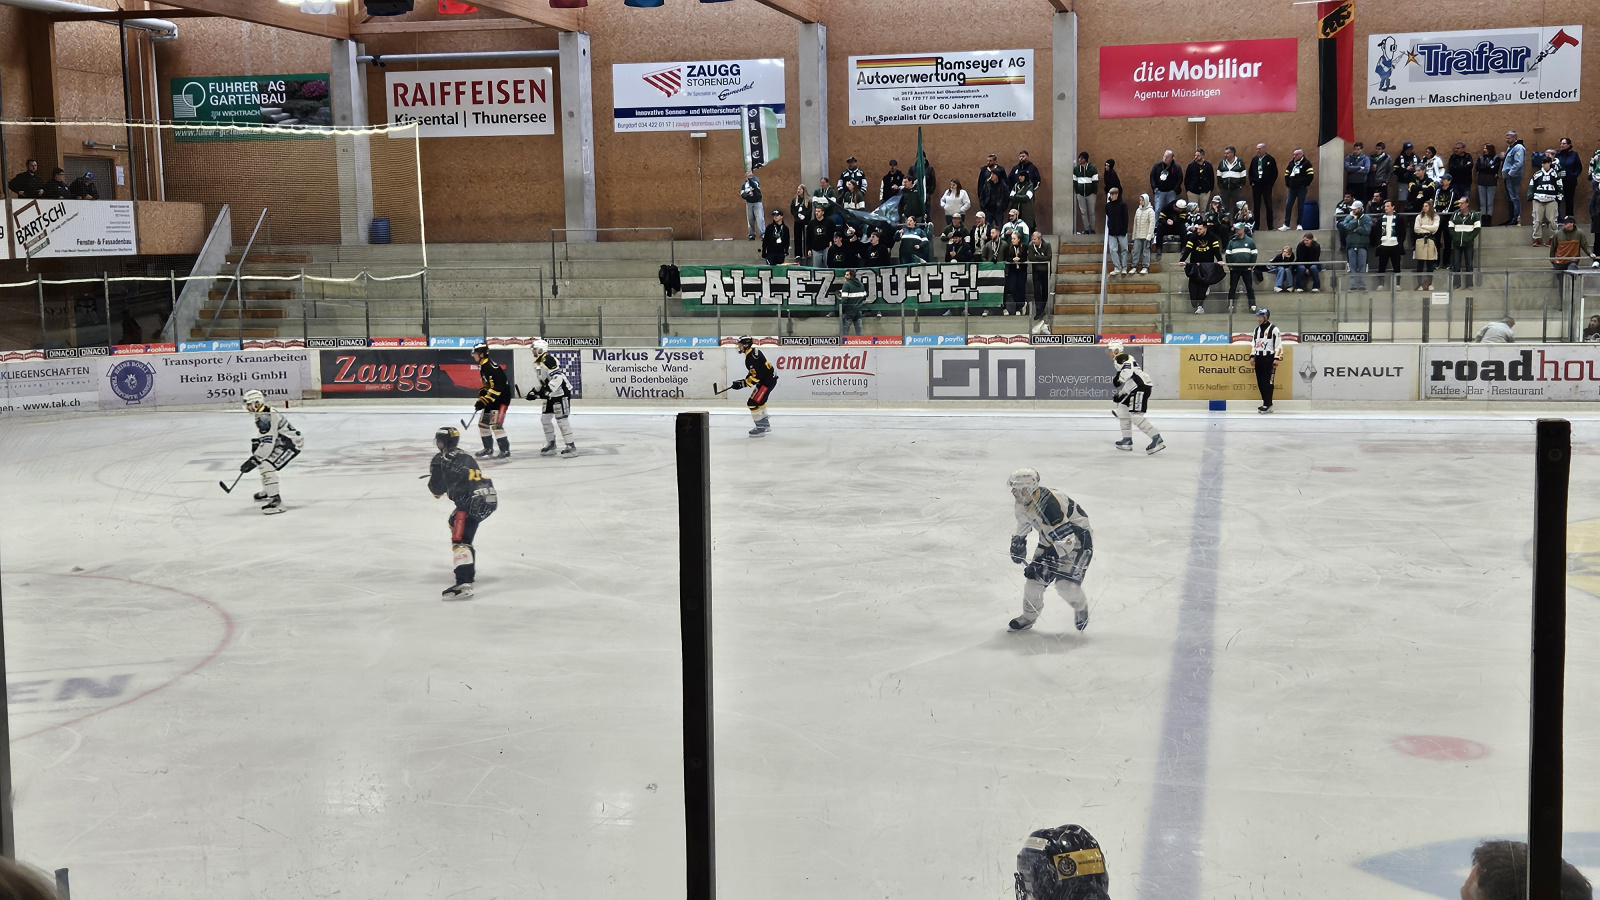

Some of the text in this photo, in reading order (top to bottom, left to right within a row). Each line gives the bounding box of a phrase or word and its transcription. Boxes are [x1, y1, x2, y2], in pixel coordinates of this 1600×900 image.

[1417, 41, 1531, 76] Trafar
[687, 64, 741, 77] ZAUGG
[935, 57, 1026, 73] Ramseyer AG
[1133, 58, 1263, 82] die Mobiliar
[687, 77, 741, 86] STORENBAU
[857, 71, 966, 86] Autoverwertung
[209, 80, 286, 94] FUHRER AG
[393, 79, 546, 107] RAIFFEISEN
[210, 93, 286, 106] GARTENBAU
[1133, 88, 1221, 101] Agentur Münsingen
[1369, 96, 1415, 107] Anlagen
[1428, 92, 1512, 103] Maschinenbau
[1519, 89, 1578, 100] Uetendorf
[665, 108, 688, 116] Sonnen-
[689, 107, 700, 115] und
[701, 106, 741, 115] Wetterschutz
[901, 104, 917, 112] Seit
[919, 103, 937, 111] über
[952, 102, 980, 110] Jahren
[472, 111, 547, 124] Thunersee
[725, 118, 741, 126] Herbli
[878, 113, 916, 123] Spezialist
[933, 111, 1017, 120] Occasionsersatzteile
[15, 202, 67, 245] BÄRTSCHI
[76, 238, 97, 246] Fenster-
[701, 264, 980, 305] ALLEZ OUTE!
[309, 339, 334, 347] DINACO
[547, 338, 569, 346] DINACO
[574, 338, 597, 346] DINACO
[913, 336, 931, 344] payfix
[1034, 336, 1059, 344] DINACO
[1067, 336, 1092, 344] DINACO
[162, 356, 224, 367] Transporte
[236, 353, 308, 364] Kranarbeiten
[592, 349, 704, 363] Markus Zysset
[776, 351, 867, 370] emmental
[1188, 353, 1251, 361] AUTO HADO
[334, 355, 435, 392] Zaugg
[605, 364, 692, 373] Keramische Wand-
[1198, 366, 1257, 374] Renault Gar
[1324, 366, 1404, 377] RENAULT
[180, 371, 288, 383] Heinz Bögli GmbH
[610, 375, 689, 386] und Bodenbeläge
[811, 376, 868, 389] versicherung
[206, 387, 289, 399] 3550 Lgnau
[616, 386, 685, 398] Wichtrach
[1050, 386, 1109, 397] architekten
[1430, 385, 1544, 395] Kaffee Bar Restaurant
[23, 398, 81, 411] www.tak.ch
